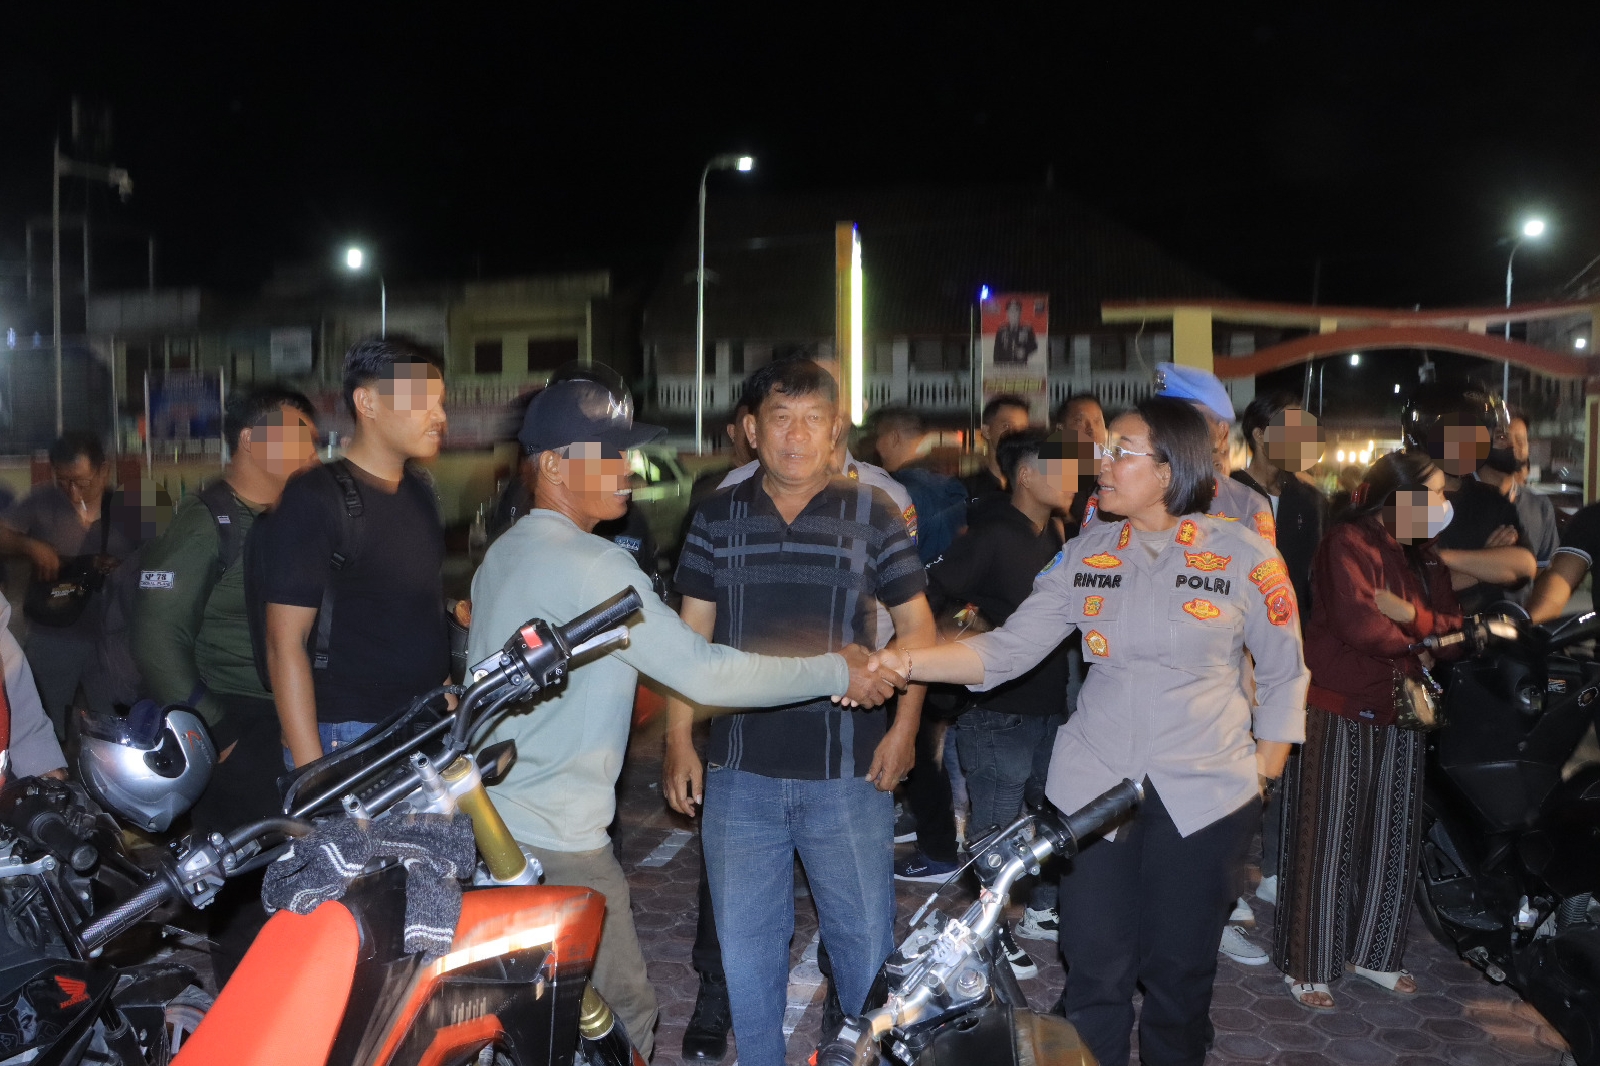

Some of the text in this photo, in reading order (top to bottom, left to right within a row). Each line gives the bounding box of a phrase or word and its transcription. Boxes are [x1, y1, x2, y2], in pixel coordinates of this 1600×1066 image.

[1073, 572, 1122, 588] RINTAR
[1175, 574, 1231, 595] POLRI
[60, 994, 90, 1009] HONDA
